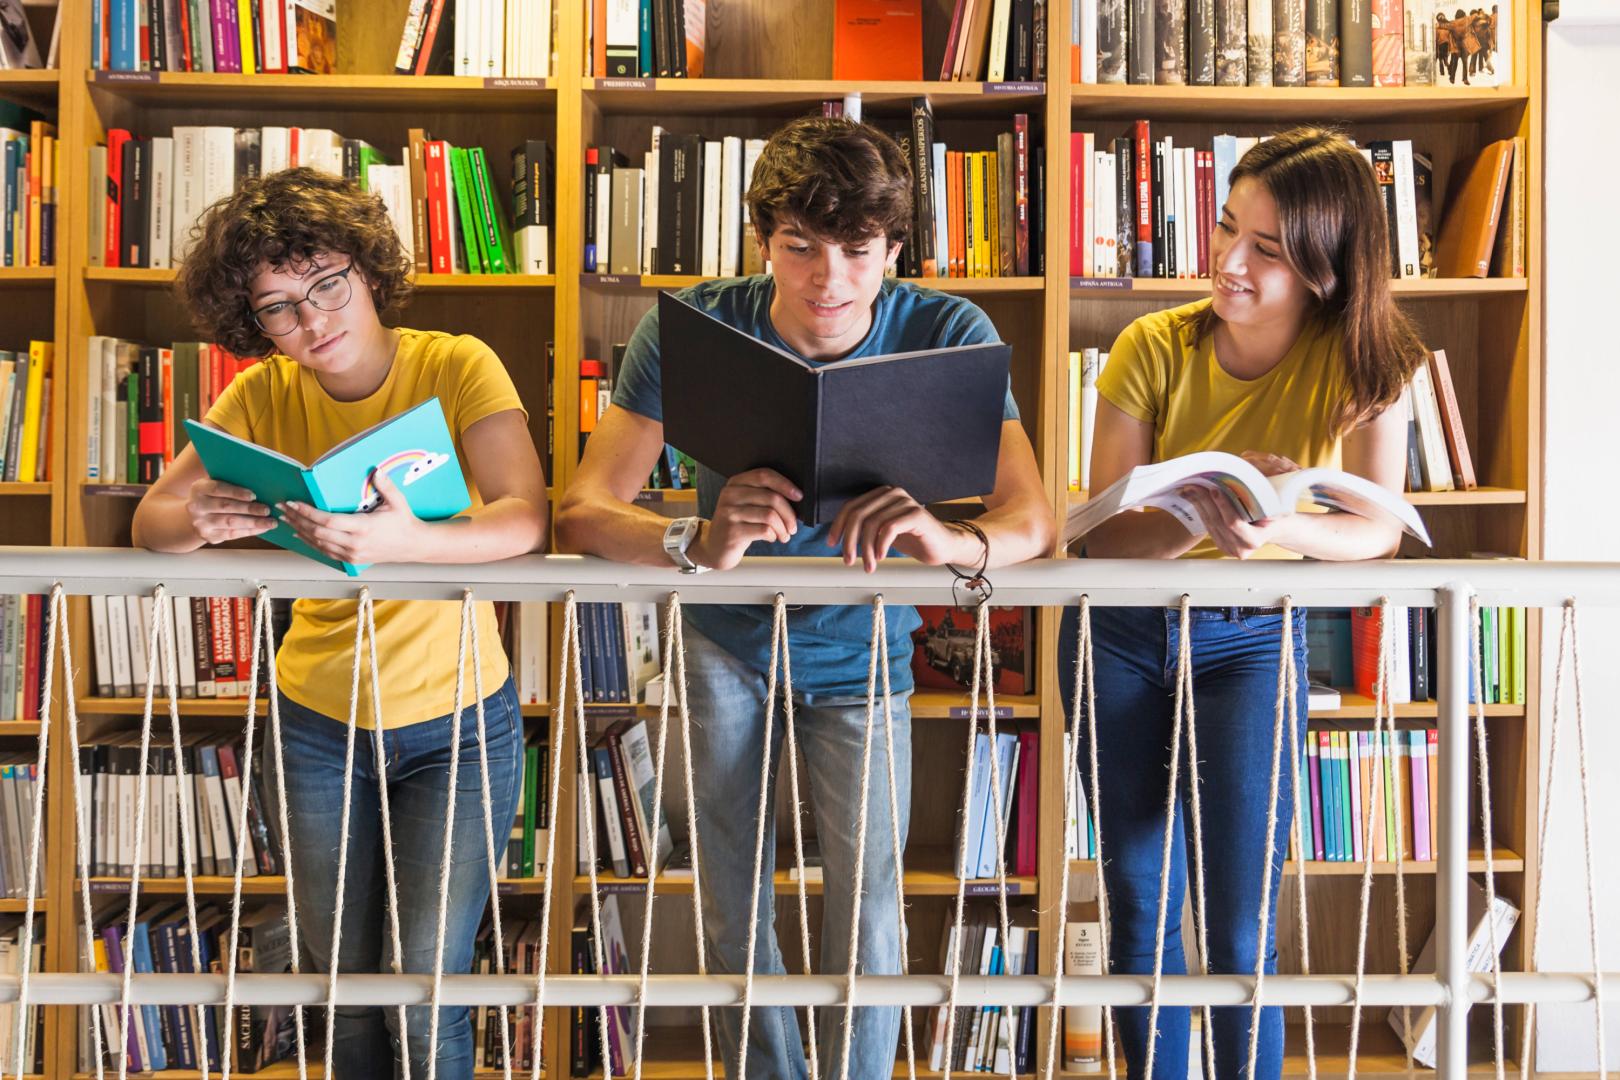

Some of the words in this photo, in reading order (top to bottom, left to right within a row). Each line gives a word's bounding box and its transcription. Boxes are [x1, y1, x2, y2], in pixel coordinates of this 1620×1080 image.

[917, 118, 926, 156] IMPERIOS
[918, 157, 928, 194] GRANDES
[214, 608, 222, 638] PUERTAS
[238, 632, 246, 662] CHOQUE
